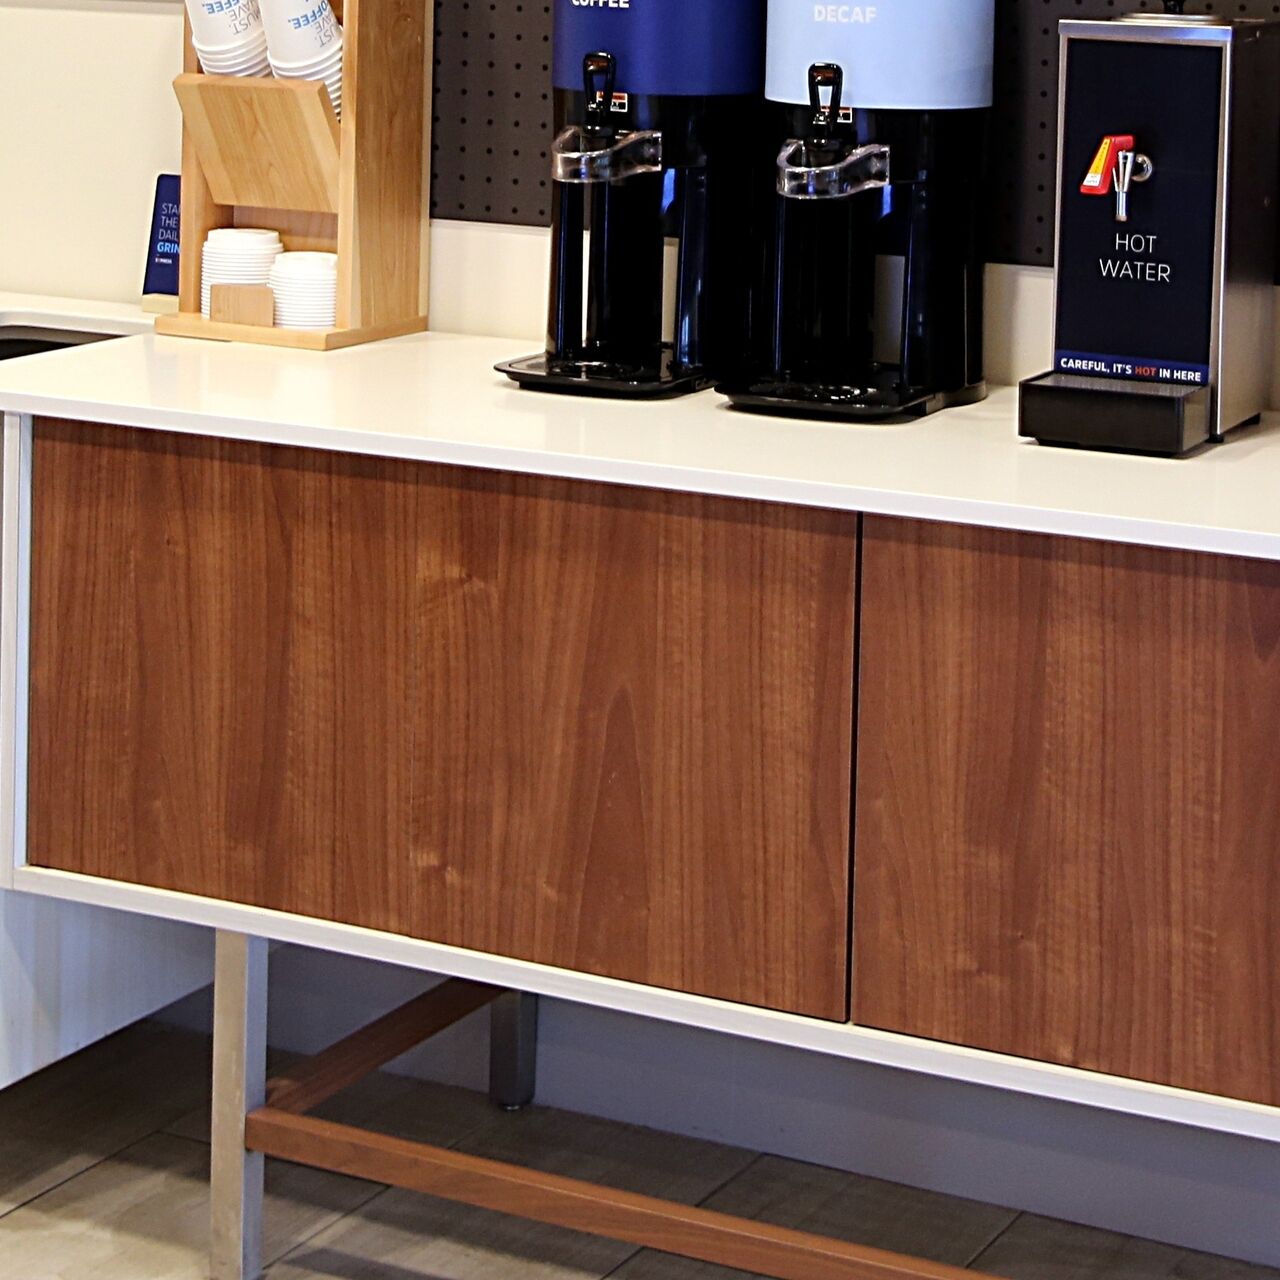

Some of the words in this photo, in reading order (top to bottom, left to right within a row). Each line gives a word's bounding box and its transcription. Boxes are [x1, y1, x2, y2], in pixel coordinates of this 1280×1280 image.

[813, 5, 877, 24] DECAF
[161, 203, 180, 215] STA
[160, 216, 178, 228] THE
[158, 229, 178, 242] DAIL
[1115, 233, 1157, 253] HOT
[157, 241, 181, 254] GRIN
[1099, 258, 1171, 282] WATER
[1060, 358, 1110, 373] CAREFUL,
[1113, 364, 1132, 374] IT'S
[1135, 366, 1157, 377] HOT
[1159, 368, 1170, 378] IN
[1173, 370, 1201, 382] HERE
